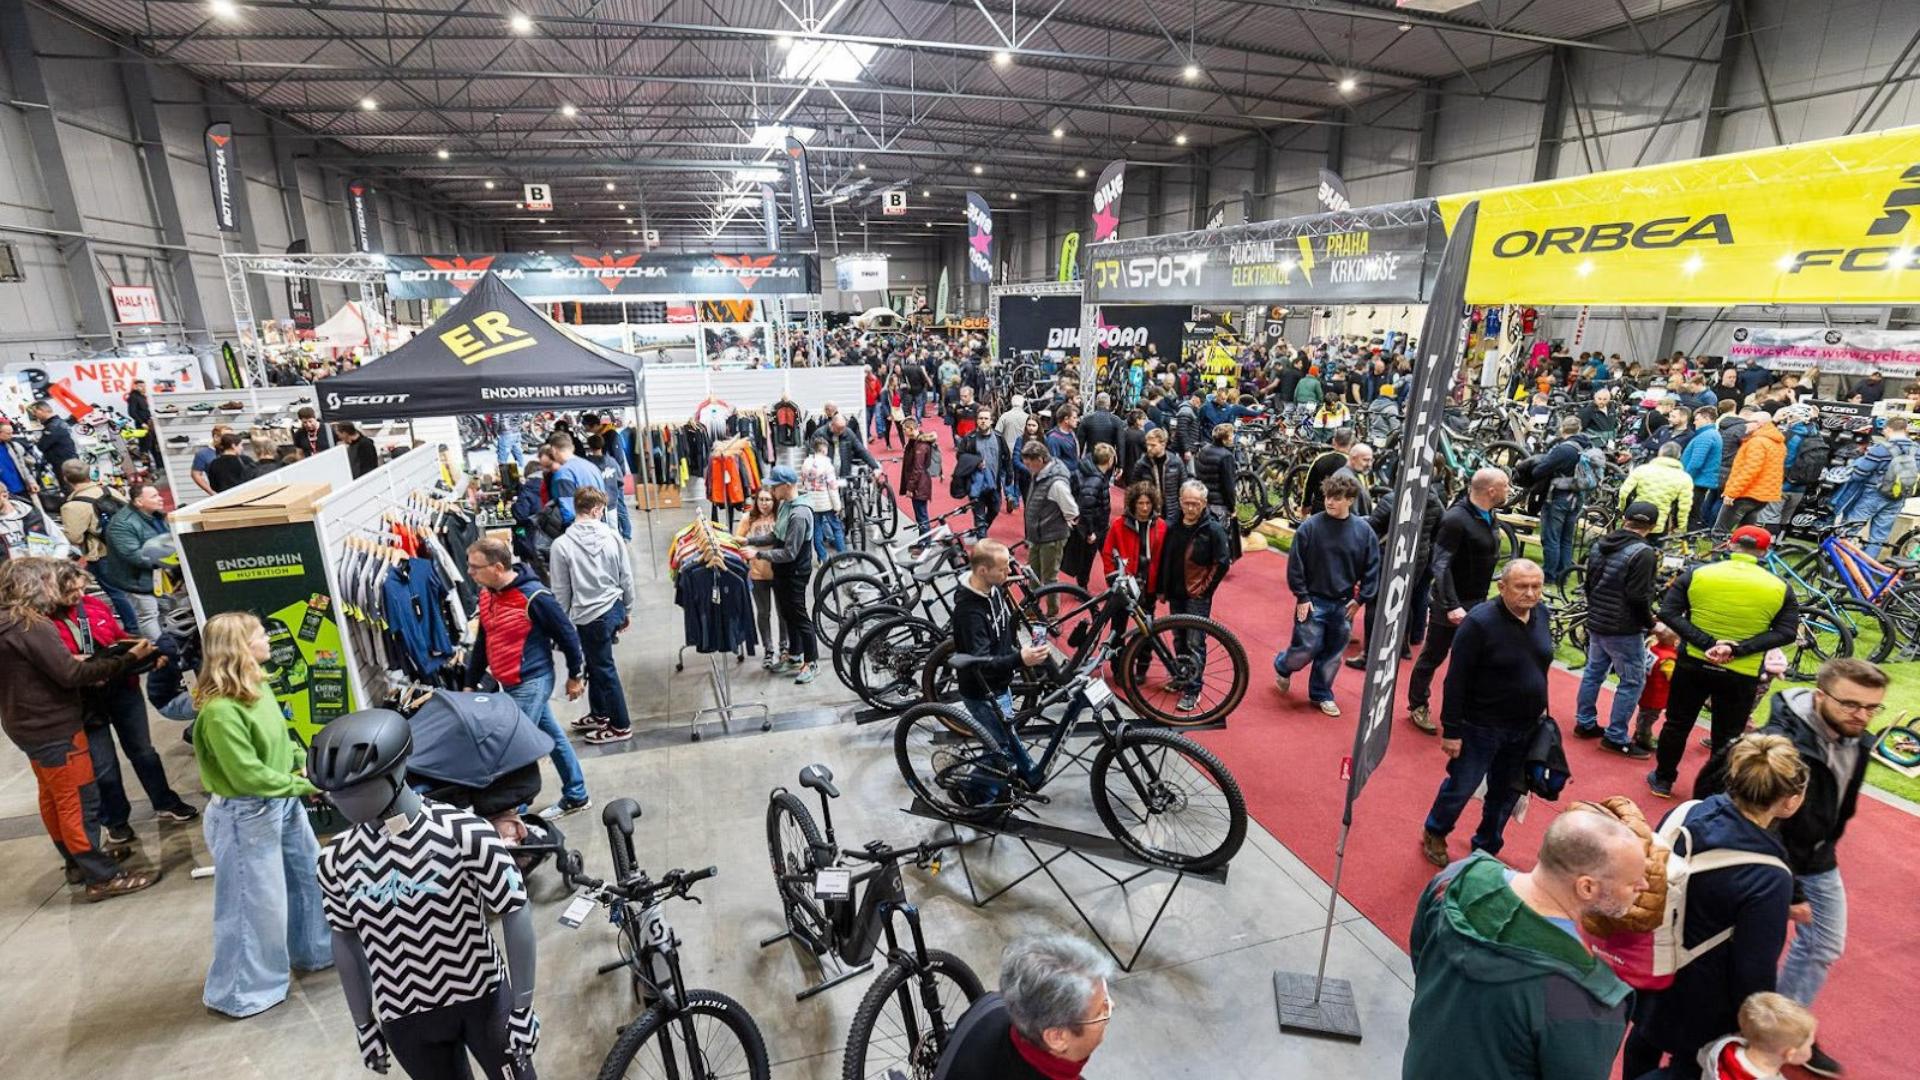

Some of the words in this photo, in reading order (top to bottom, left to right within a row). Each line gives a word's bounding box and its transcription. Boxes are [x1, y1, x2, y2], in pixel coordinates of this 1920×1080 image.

[216, 148, 233, 228] BOTTECCHIA
[530, 187, 544, 200] B
[1093, 173, 1124, 213] BIKE
[891, 194, 902, 206] B
[1326, 231, 1369, 258] PRAHA
[1493, 213, 1735, 259] ORBEA
[1330, 251, 1400, 283] KRKONOŠE
[1788, 245, 1920, 273] FO
[401, 267, 525, 281] BOTTECHIA
[552, 266, 667, 279] BOTTECCHIA
[692, 266, 800, 279] BOTTECCHIA
[439, 310, 529, 358] ER
[74, 361, 138, 381] NEW
[101, 380, 137, 393] ER
[342, 394, 410, 405] SCOTT
[481, 385, 560, 400] ENDORPHIN
[564, 383, 627, 397] REPUBLIC
[216, 552, 302, 571] ENDORPHIN
[236, 568, 289, 578] NUTRITION
[688, 1000, 728, 1010] MAXXIS
